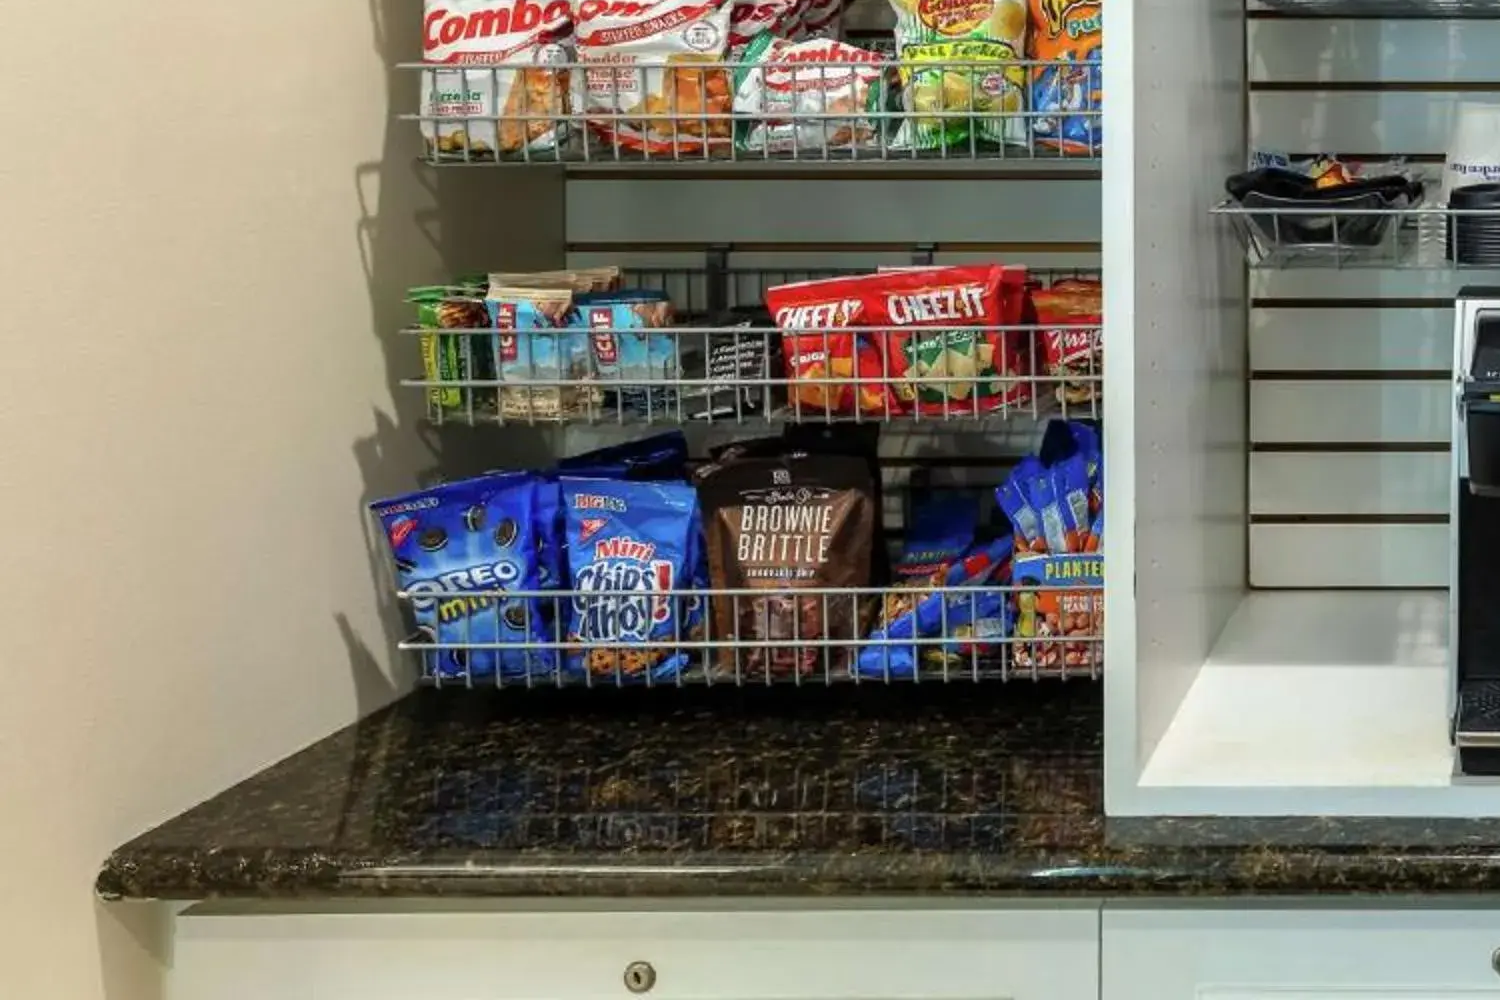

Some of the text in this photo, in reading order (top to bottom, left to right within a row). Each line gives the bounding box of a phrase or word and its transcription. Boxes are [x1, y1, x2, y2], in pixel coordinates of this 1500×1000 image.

[741, 504, 833, 535] BROWNIE
[595, 536, 656, 562] Mini
[738, 534, 831, 564] BRITTLE
[404, 560, 519, 611] OREO
[573, 561, 655, 594] Chips
[1044, 561, 1104, 580] PLANTE
